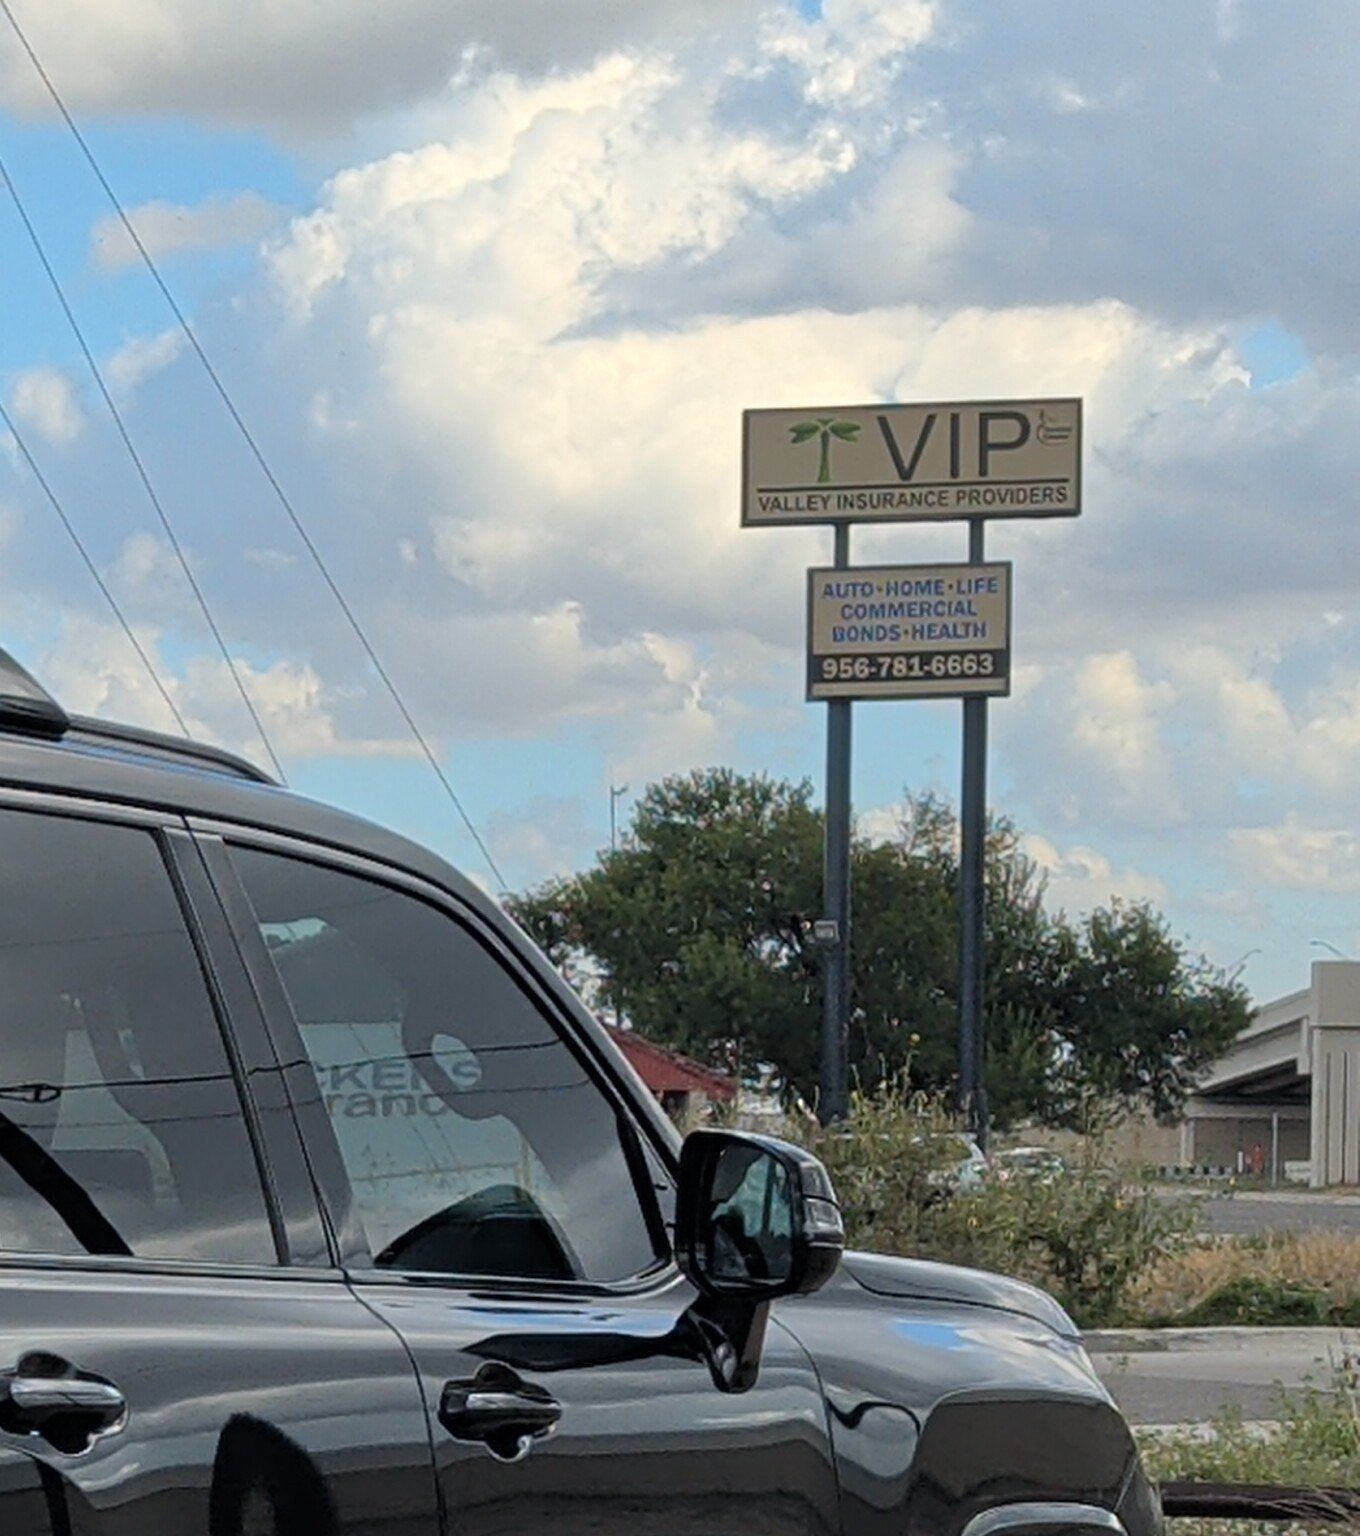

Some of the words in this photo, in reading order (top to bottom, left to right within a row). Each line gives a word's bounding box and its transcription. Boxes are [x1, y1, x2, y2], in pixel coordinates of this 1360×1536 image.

[877, 411, 1030, 481] VIP
[757, 493, 830, 512] VALLEY
[837, 490, 949, 509] INSURANCE
[955, 486, 1068, 506] PROVIDERS
[840, 600, 978, 620] COMMERCIAL
[821, 653, 995, 680] 956-781-6663
